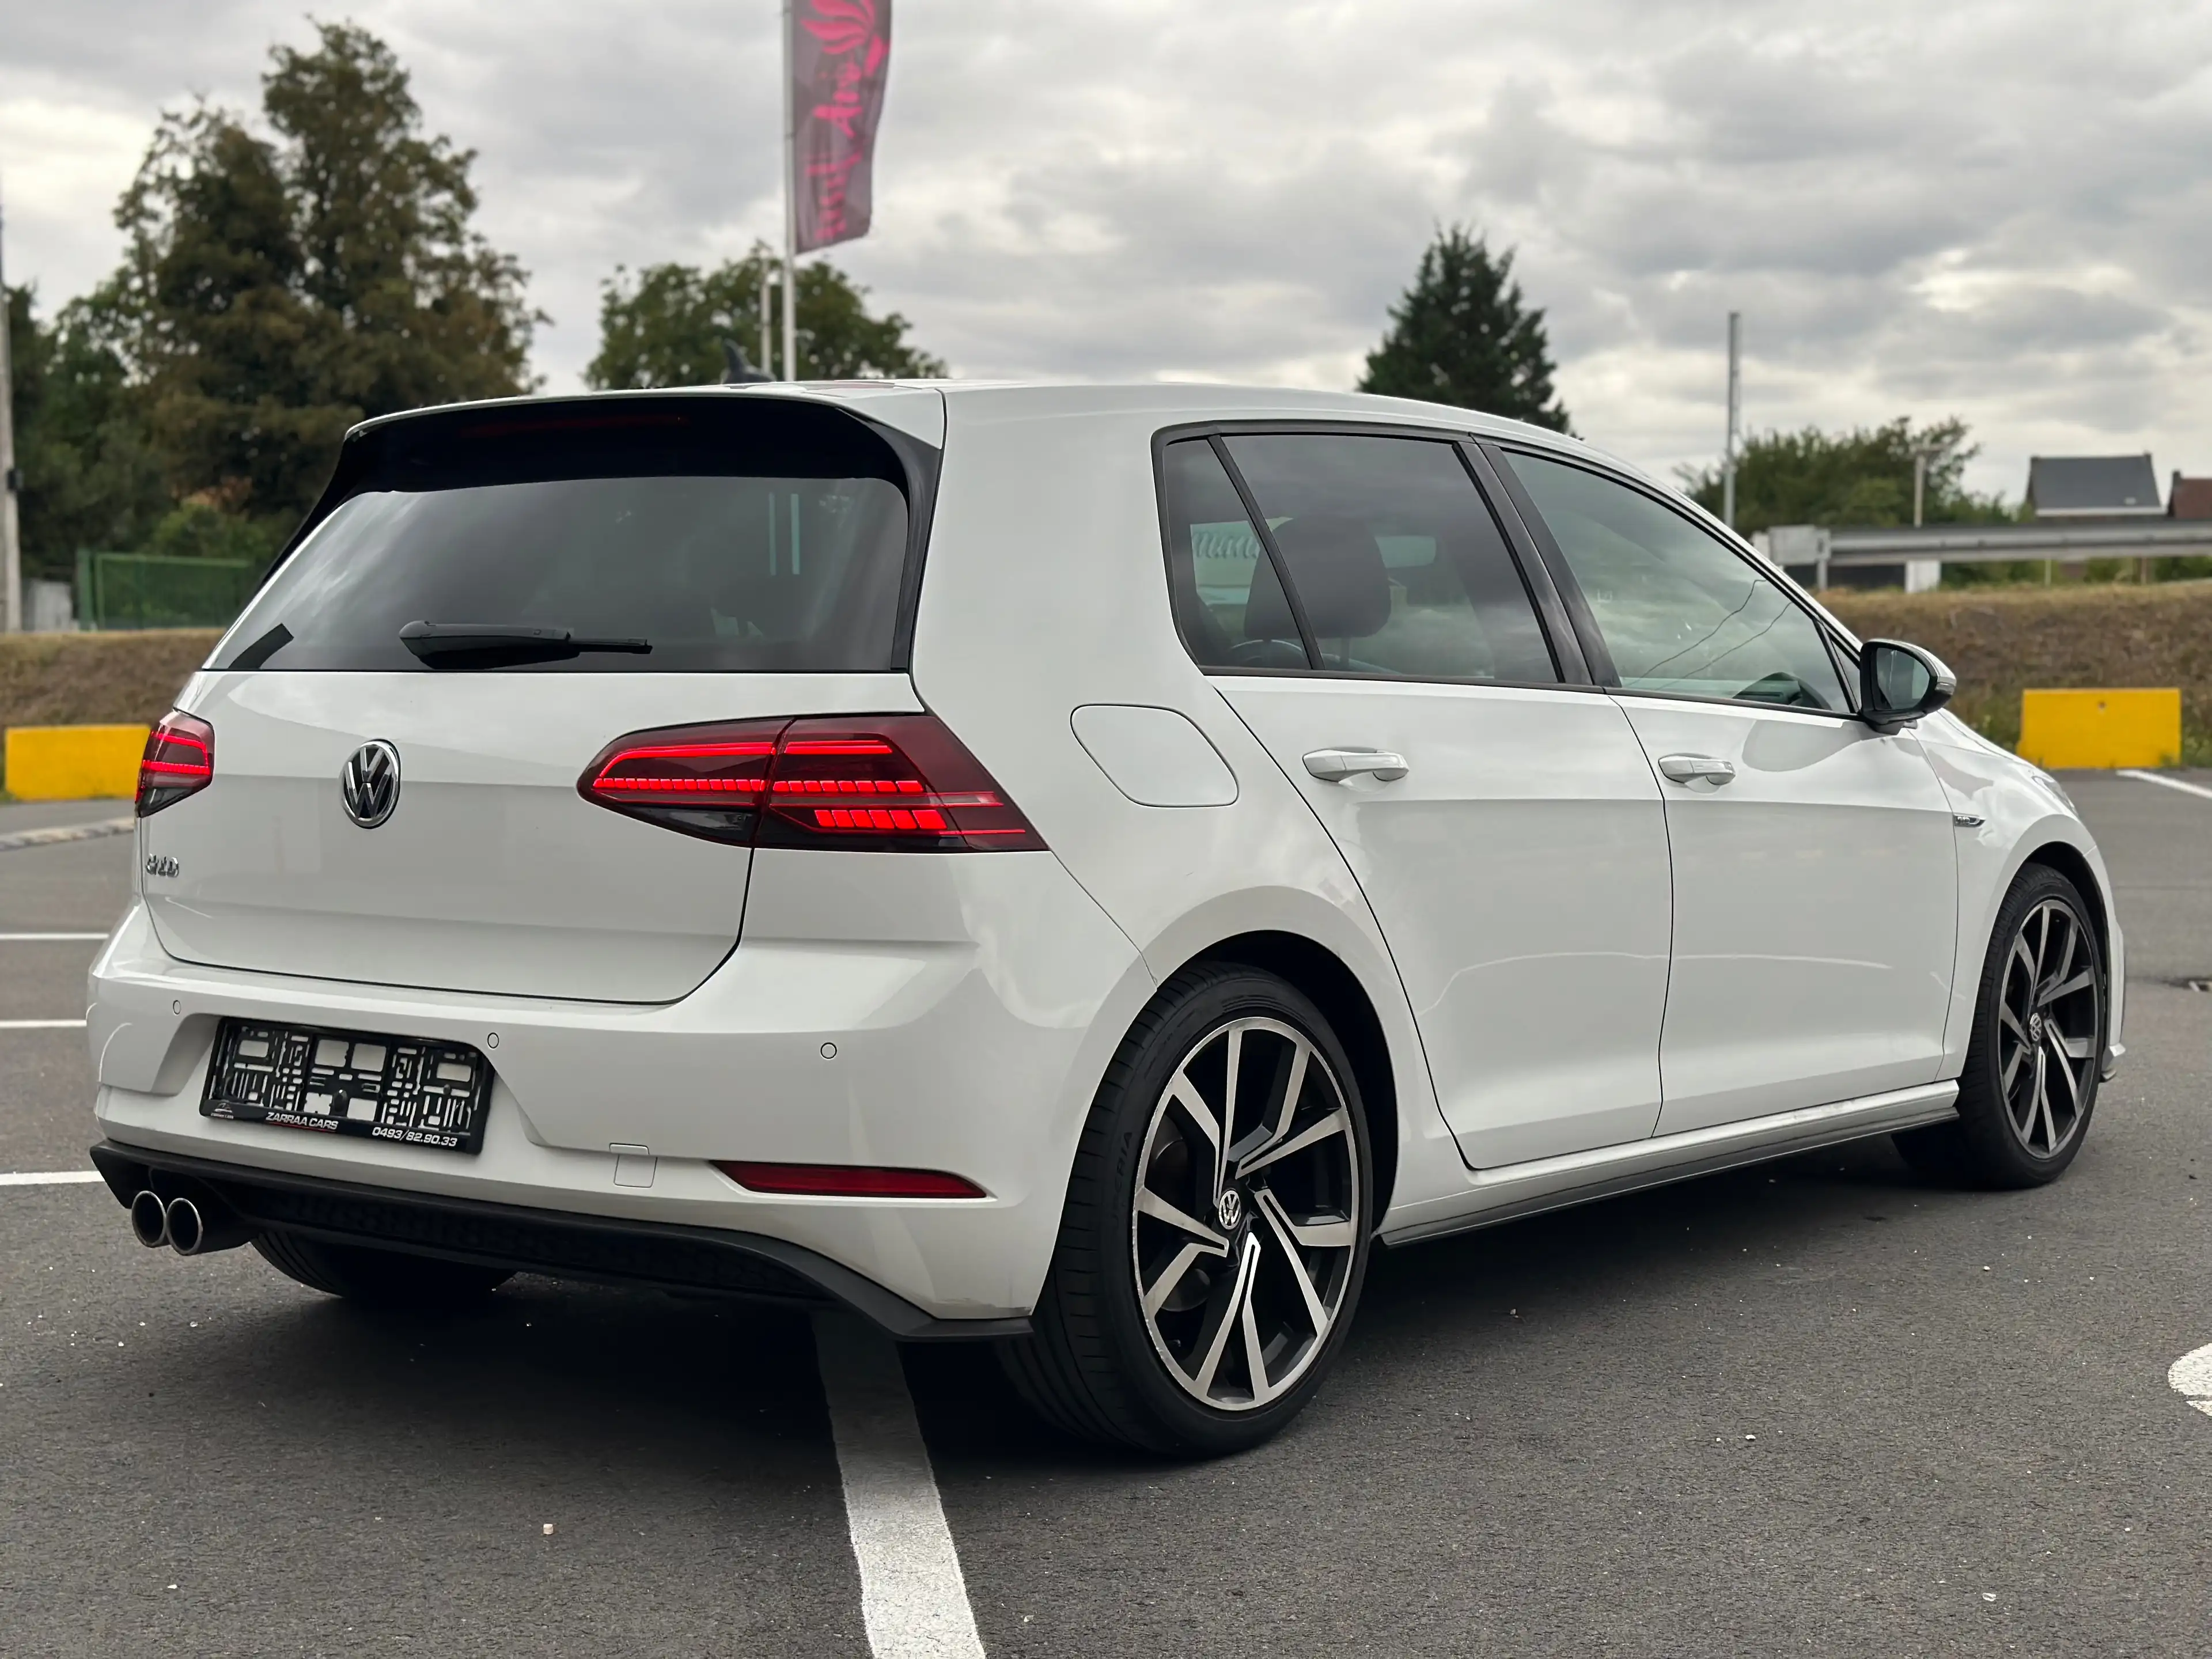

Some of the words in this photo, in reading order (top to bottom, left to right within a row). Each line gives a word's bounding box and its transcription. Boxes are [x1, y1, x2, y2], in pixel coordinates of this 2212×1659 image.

[342, 741, 399, 826] VW
[266, 1112, 308, 1125] ZARRAA
[309, 1118, 339, 1131] CARS
[372, 1127, 457, 1147] 0493/82.90.33
